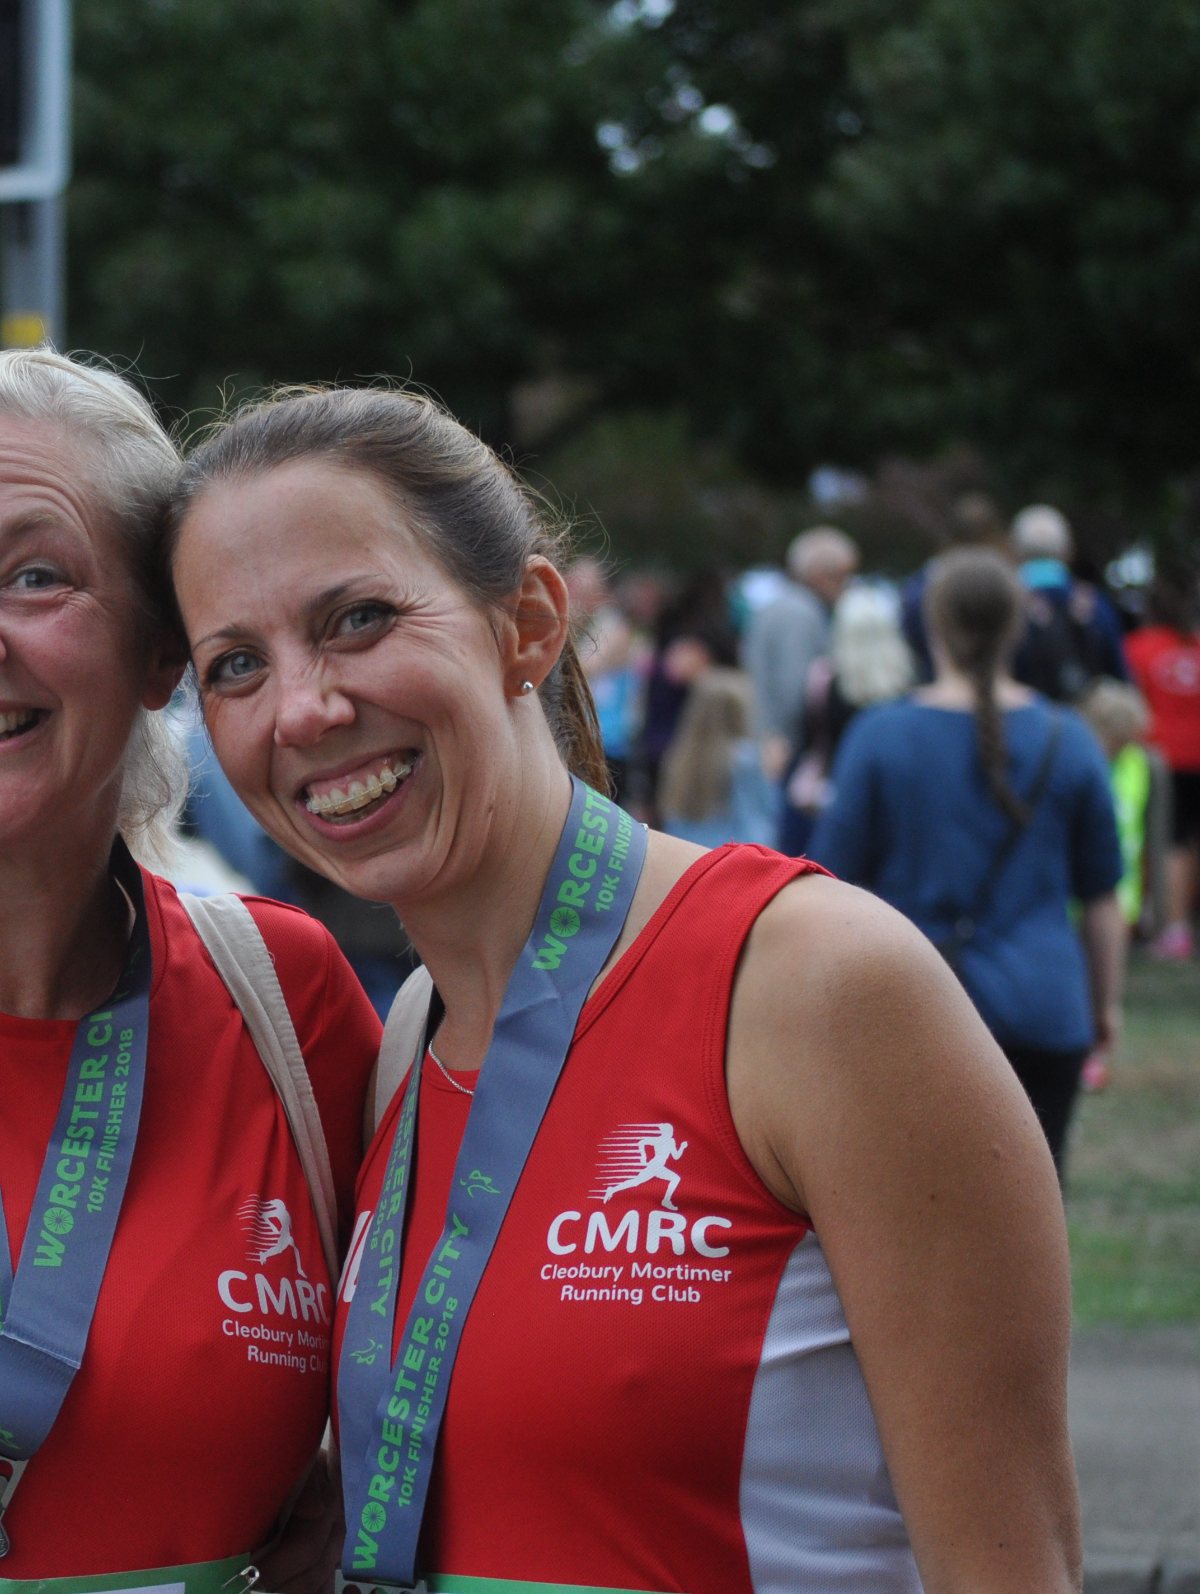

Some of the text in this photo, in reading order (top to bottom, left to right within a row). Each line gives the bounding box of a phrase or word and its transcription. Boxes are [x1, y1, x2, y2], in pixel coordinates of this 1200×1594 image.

[595, 874, 621, 912] 10K
[87, 1028, 134, 1214] 10K FINISHER 2018
[33, 1054, 108, 1267] WORCESTER
[547, 1209, 732, 1258] CMRC
[540, 1262, 732, 1282] Cleobury Mortimer
[560, 1285, 701, 1305] Running Club
[222, 1319, 293, 1347] Cleobury
[247, 1344, 307, 1373] Running
[353, 1316, 434, 1569] WORCESTER
[425, 1213, 469, 1305] CITY
[398, 1296, 459, 1507] 10K FINISHER 2018
